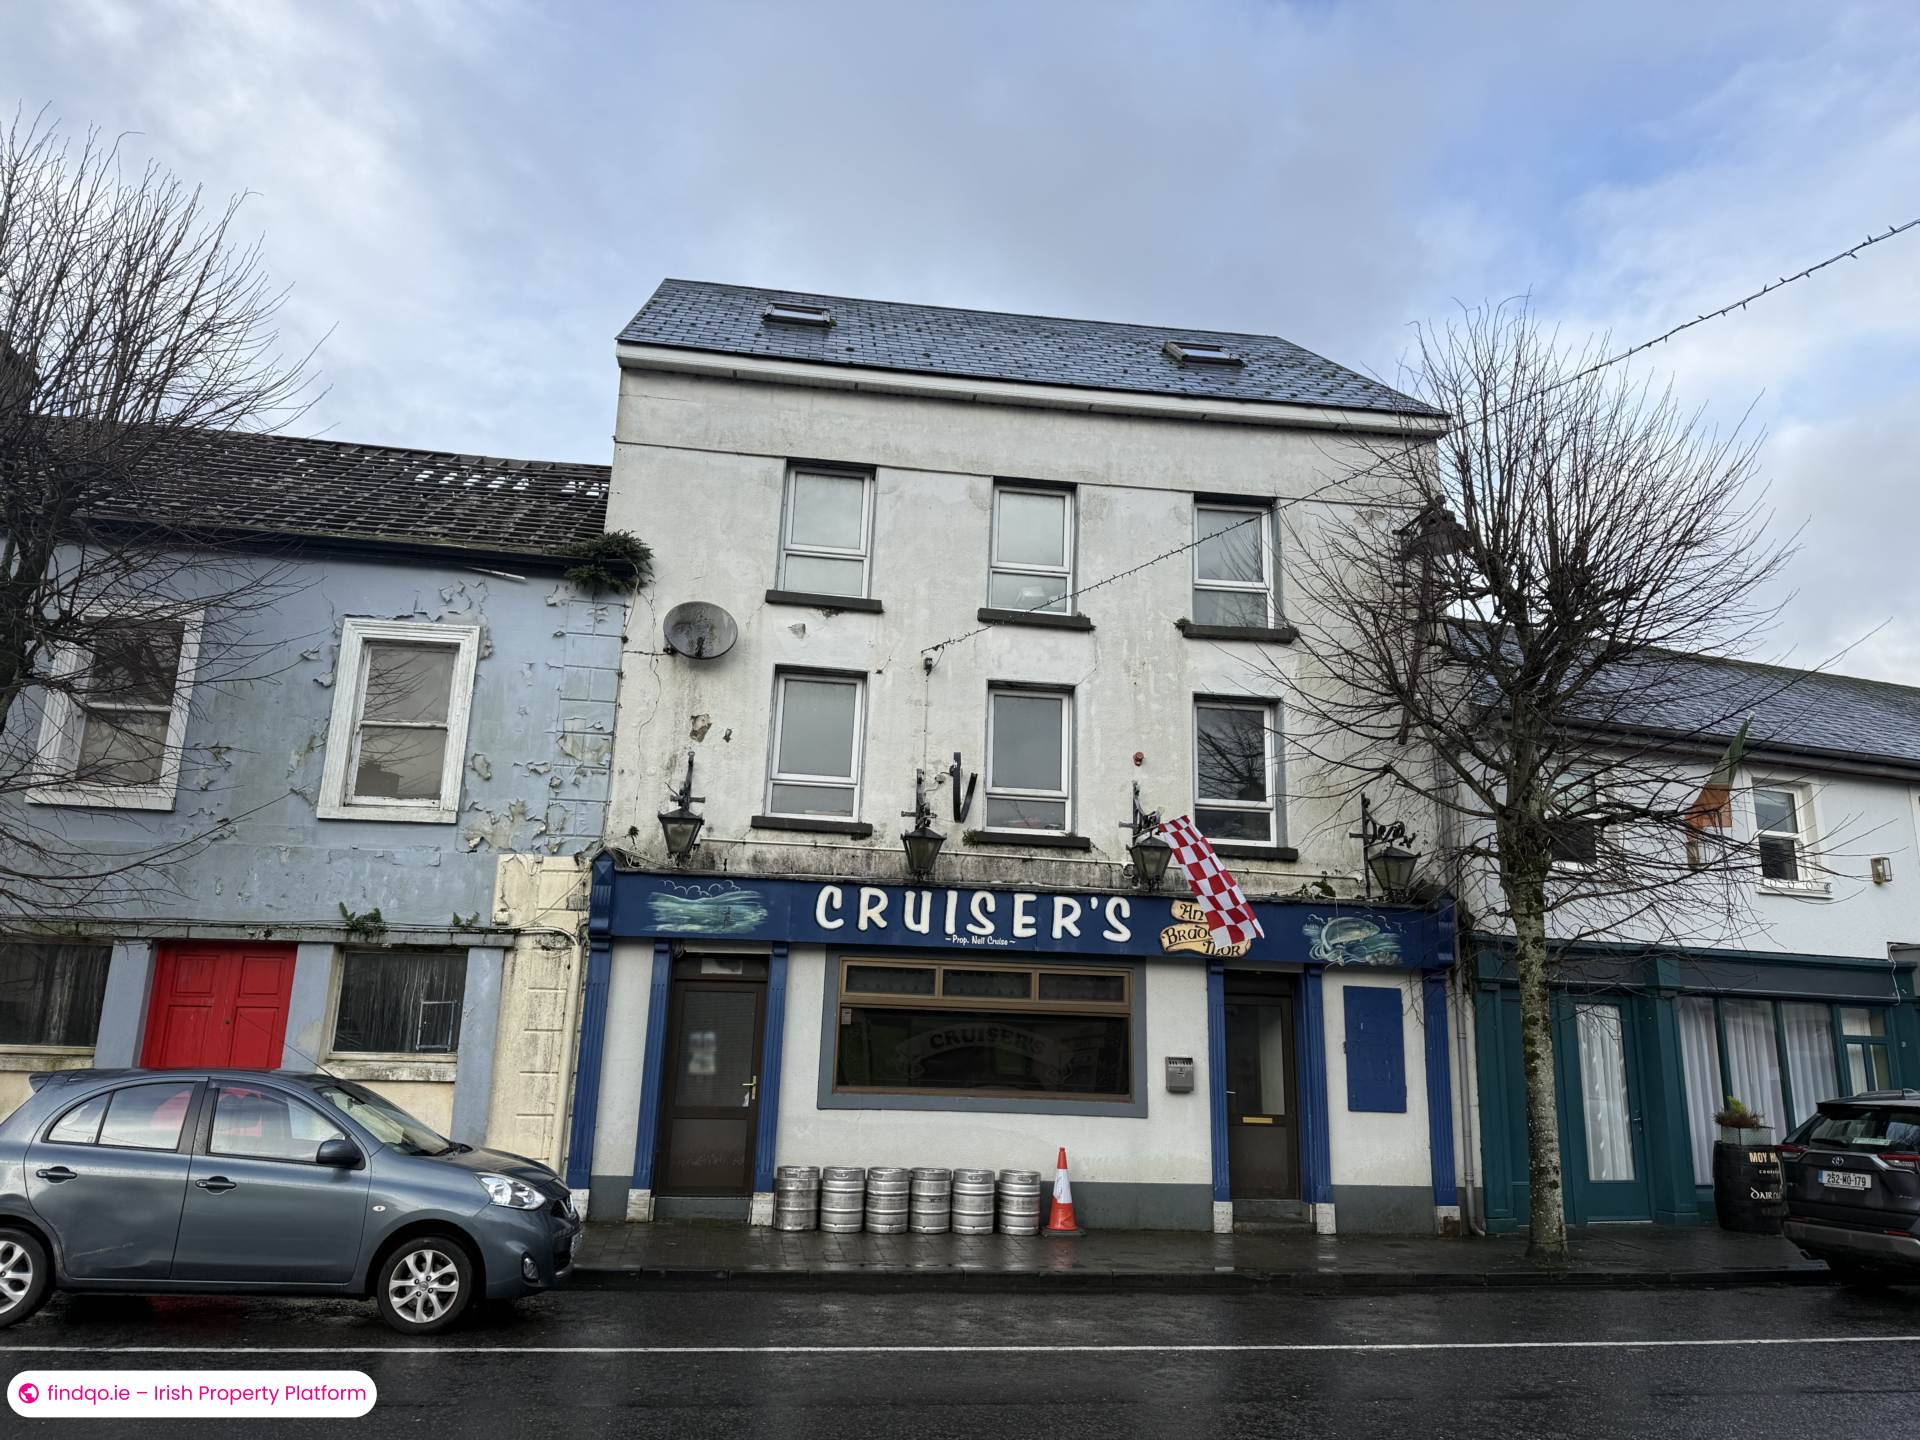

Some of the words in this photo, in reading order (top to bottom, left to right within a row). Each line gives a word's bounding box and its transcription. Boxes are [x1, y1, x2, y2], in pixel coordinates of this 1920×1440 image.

[815, 885, 1132, 943] CRUISER'S
[952, 934, 970, 946] Prop.
[987, 935, 1008, 946] Cruise
